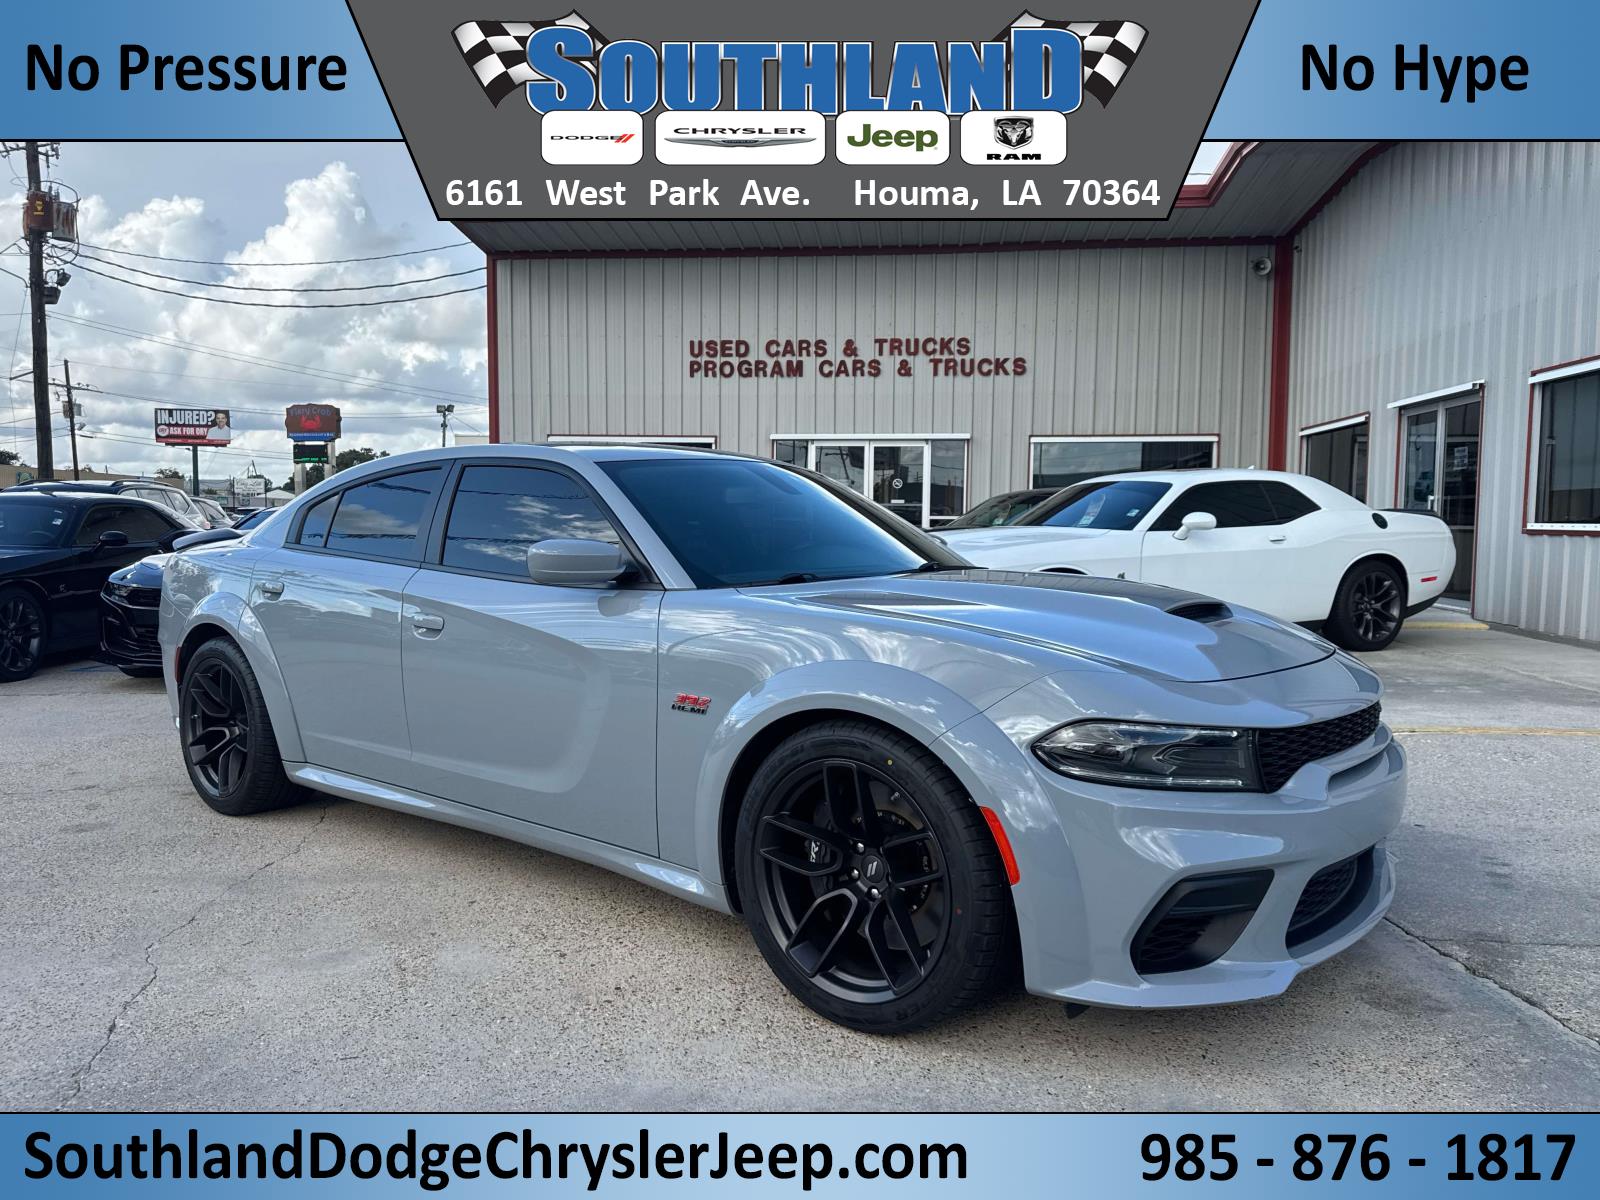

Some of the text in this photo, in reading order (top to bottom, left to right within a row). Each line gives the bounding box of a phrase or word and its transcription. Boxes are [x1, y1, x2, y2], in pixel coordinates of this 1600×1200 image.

[689, 336, 971, 358] USED CARS & TRUCKS
[689, 357, 1027, 379] PROGRAM CARS & TRUCKS
[157, 409, 216, 426] INJURED?
[170, 427, 182, 435] ASK
[183, 427, 195, 436] FOR
